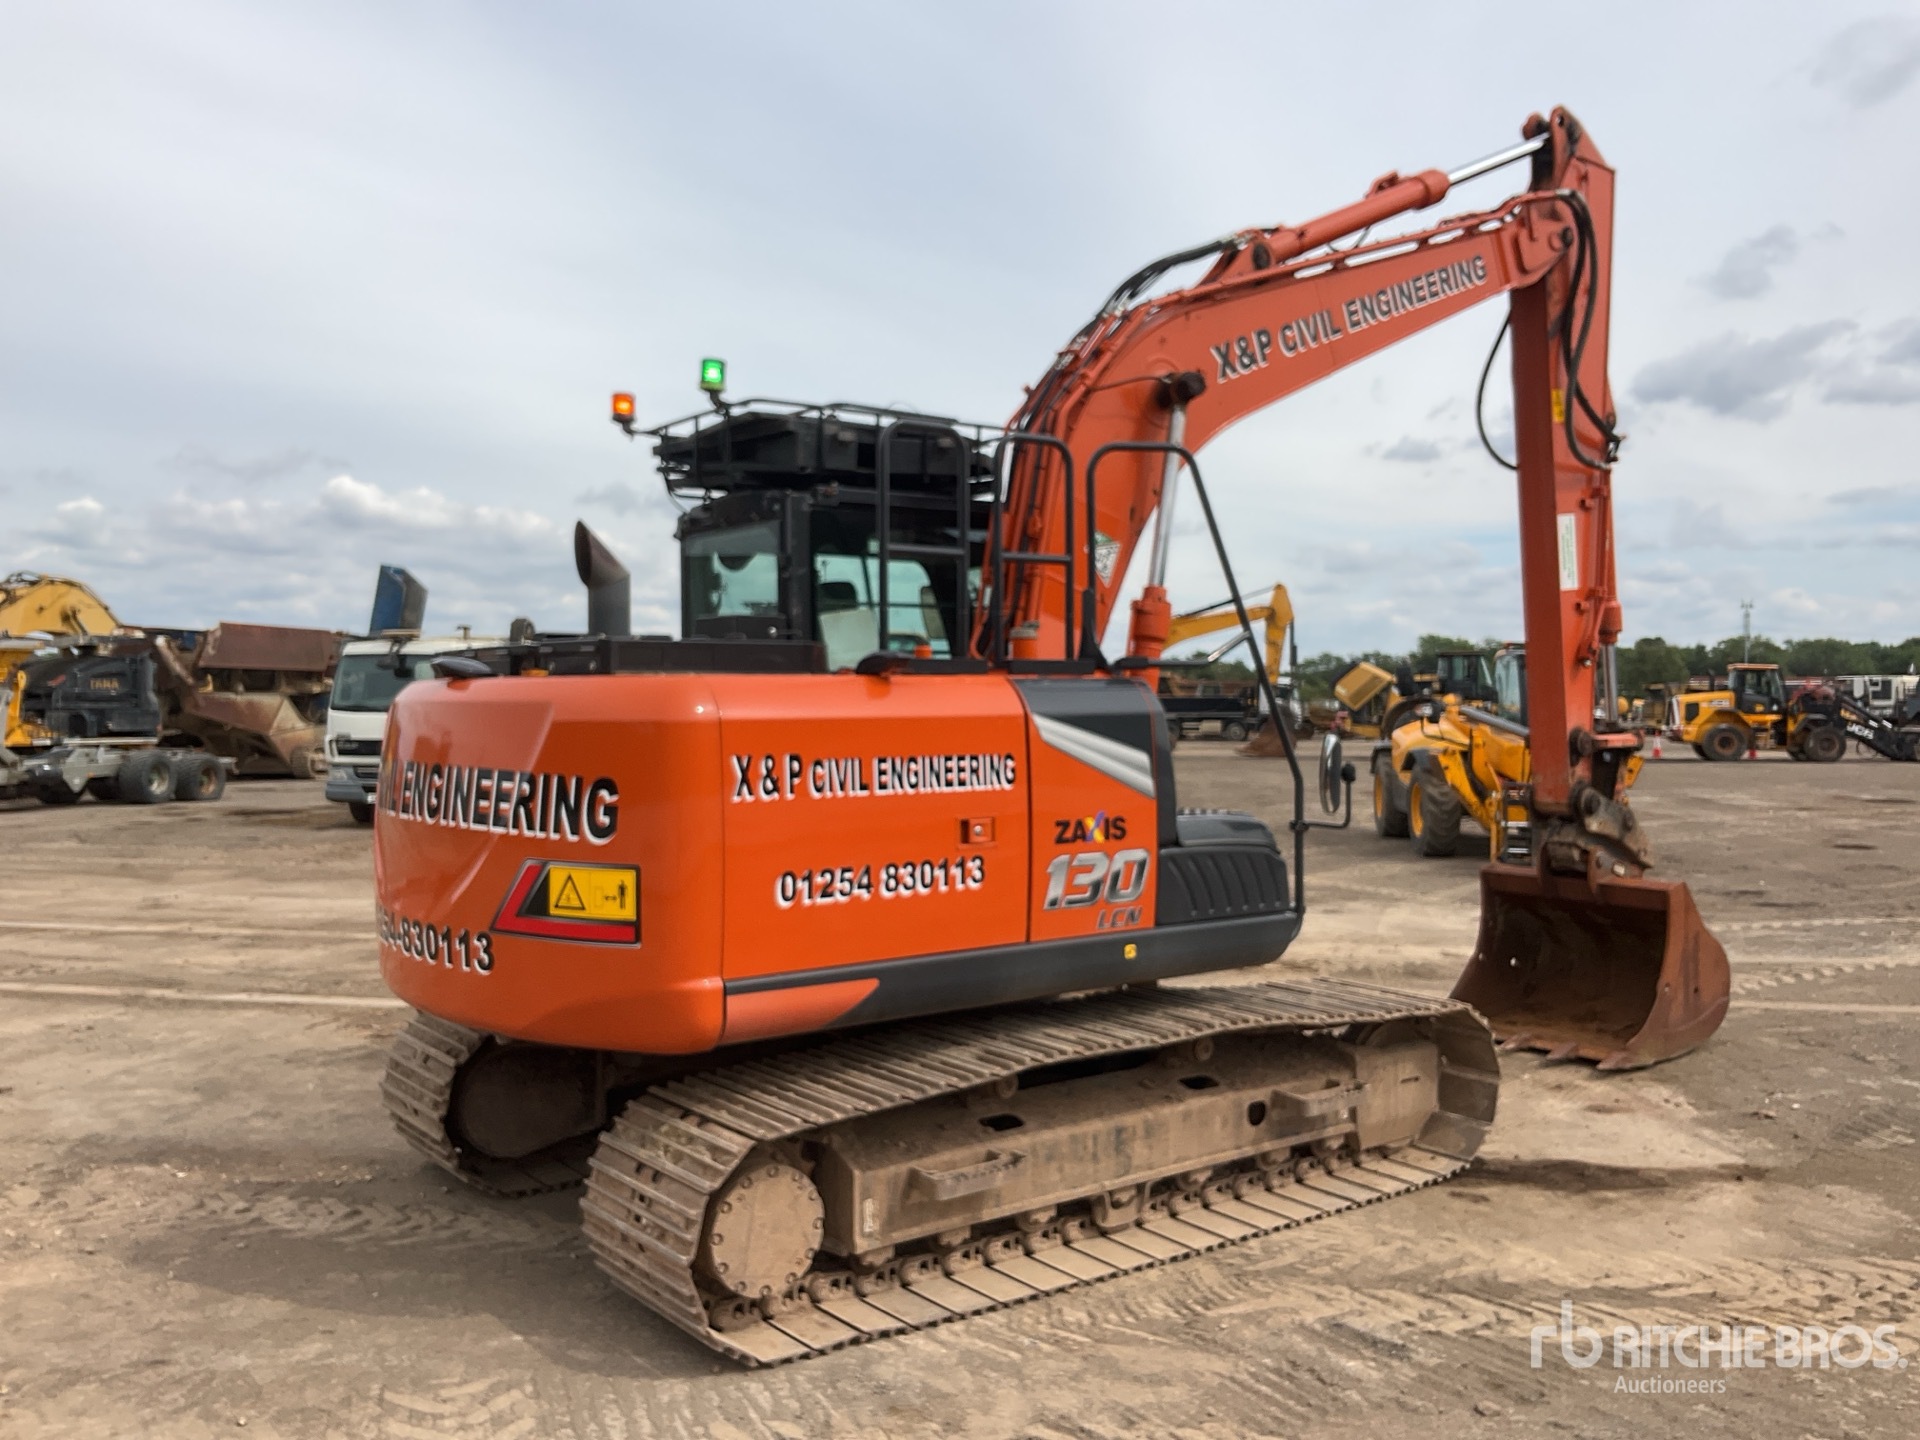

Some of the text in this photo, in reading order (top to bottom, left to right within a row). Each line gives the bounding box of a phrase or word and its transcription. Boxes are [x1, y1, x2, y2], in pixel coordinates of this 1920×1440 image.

[1210, 254, 1488, 384] X&P CIVIL ENGINEERING
[399, 760, 620, 845] ENGINEERING
[731, 752, 1016, 803] X & P CIVIL ENGINEERING
[1054, 810, 1128, 845] ZAXIS
[775, 855, 986, 910] 01254 830113
[1043, 848, 1151, 911] 130
[1096, 905, 1143, 929] LCN
